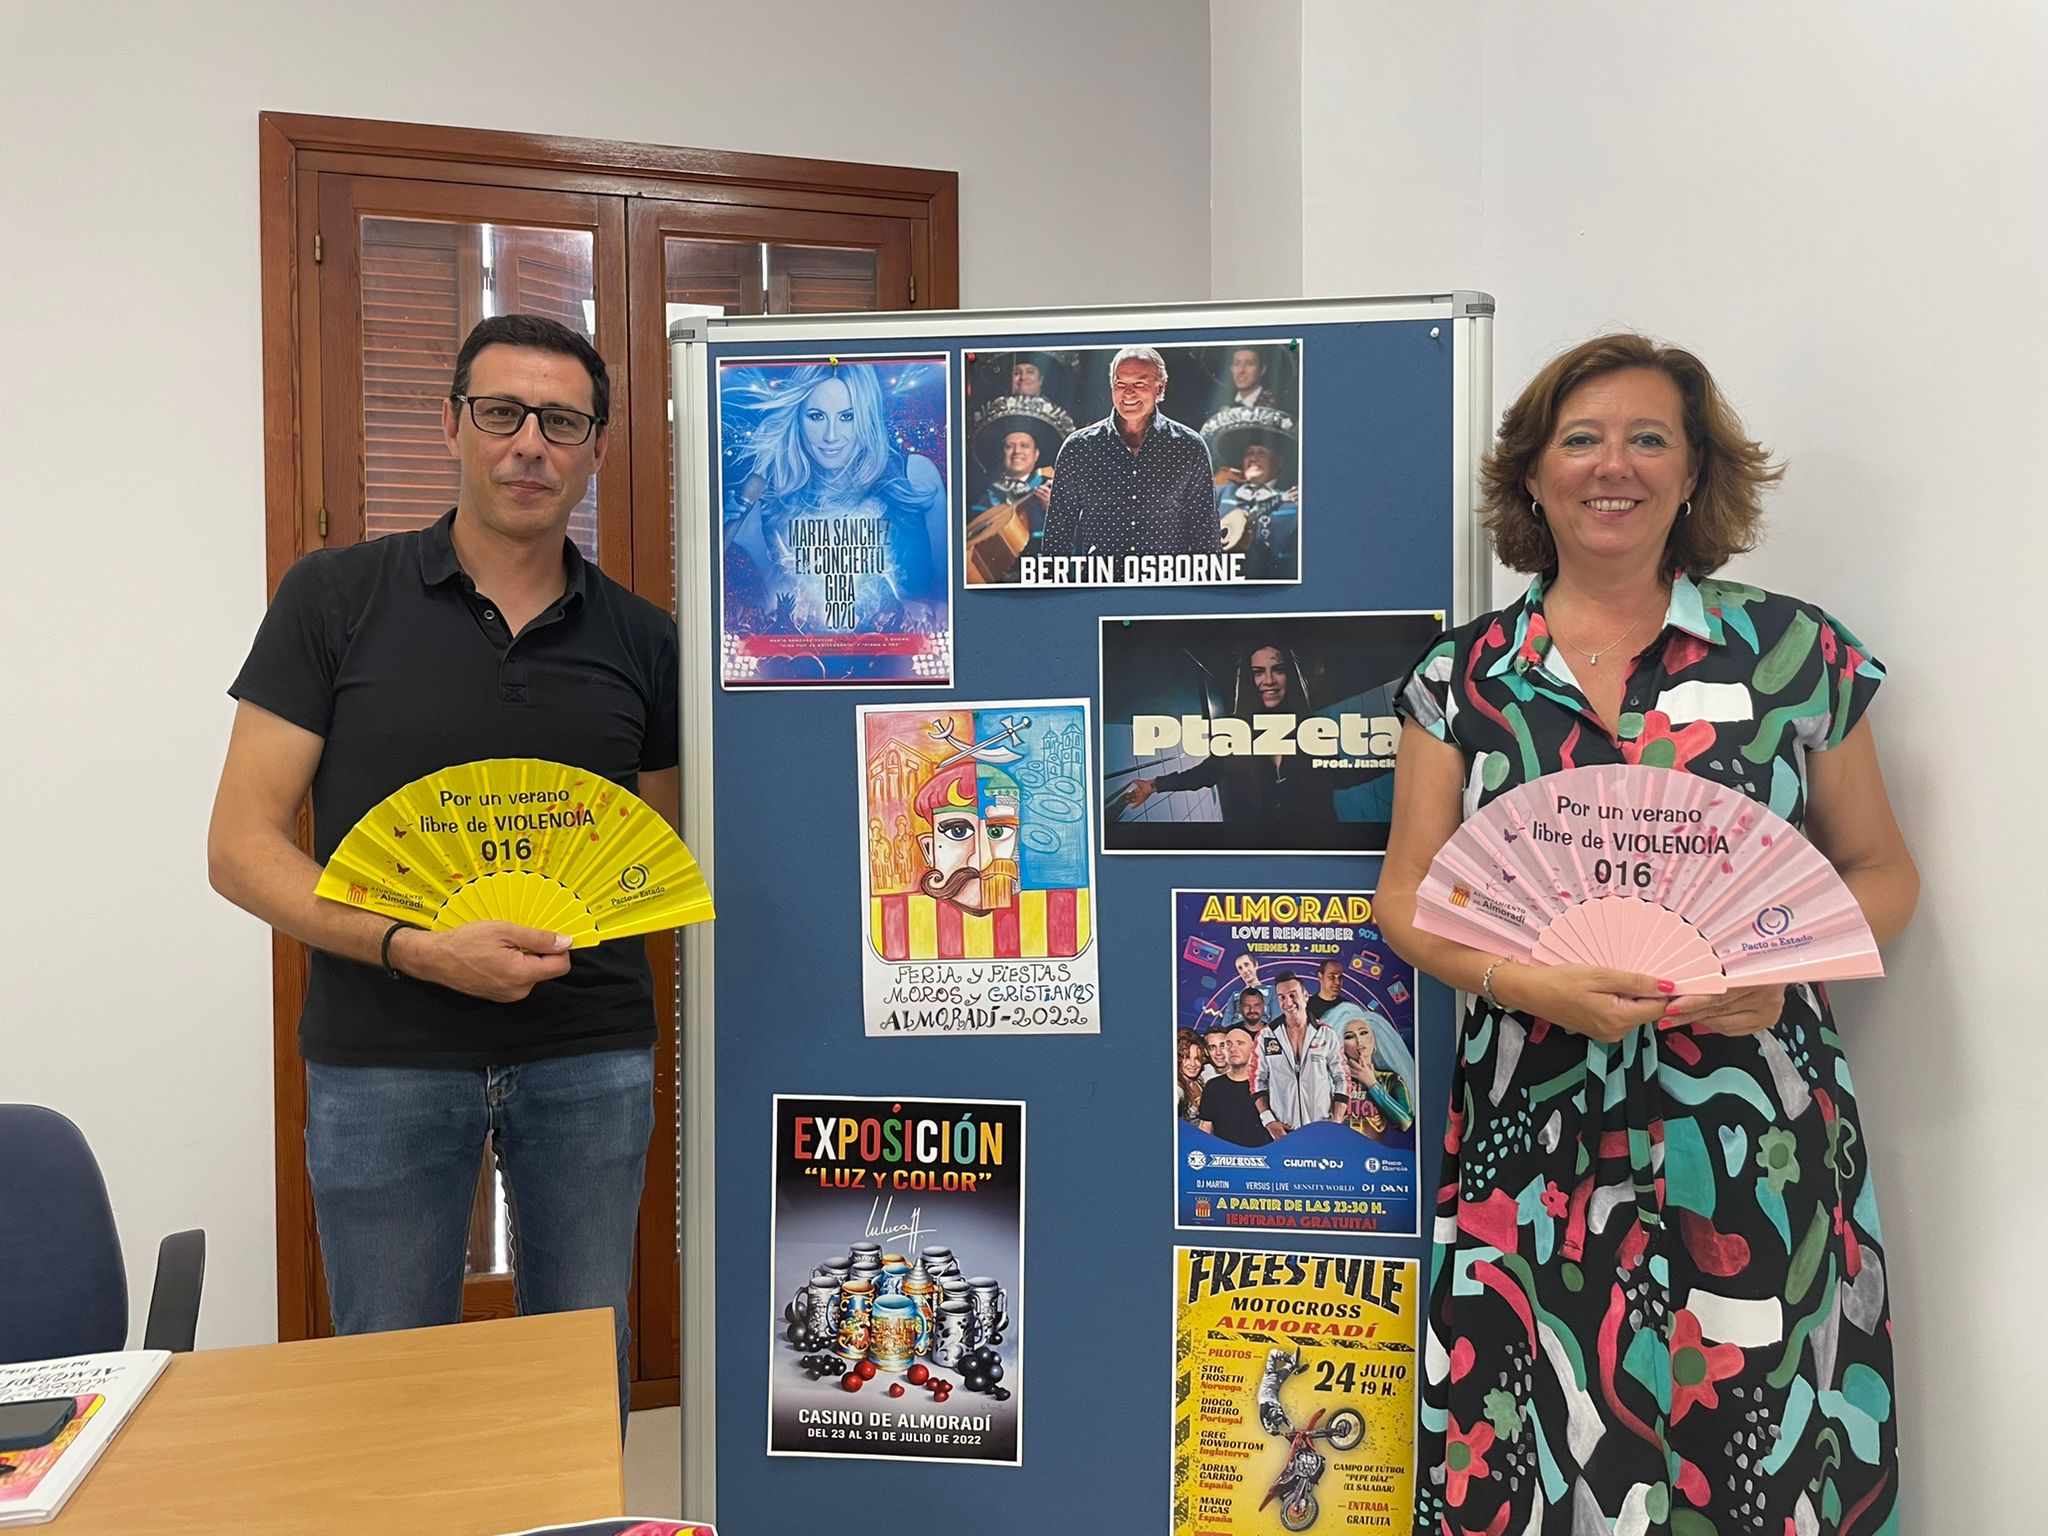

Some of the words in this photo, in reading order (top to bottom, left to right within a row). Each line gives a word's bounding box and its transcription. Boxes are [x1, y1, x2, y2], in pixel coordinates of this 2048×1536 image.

[788, 519, 830, 547] MARTA
[834, 514, 891, 546] SÁNCHEZ
[795, 547, 811, 575] EN
[814, 546, 884, 574] CONCIERTO
[1020, 545, 1114, 584] BERTÍN
[1123, 553, 1246, 583] OSBORNE
[825, 574, 856, 602] GIRA
[825, 601, 855, 630] 2020
[1132, 713, 1402, 757] PtaZeta
[1312, 758, 1353, 769] Prod.
[1354, 758, 1396, 769] Juack
[440, 790, 471, 807] Por
[479, 794, 502, 806] un
[509, 789, 570, 805] verano
[1556, 796, 1590, 817] Por
[1598, 806, 1624, 821] un
[1631, 808, 1702, 825] verano
[420, 816, 459, 834] libre
[466, 815, 488, 833] de
[494, 809, 596, 832] VIOLENCIA
[1532, 821, 1573, 847] libre
[1581, 828, 1604, 849] de
[1612, 833, 1730, 856] VIOLENCIA
[481, 838, 532, 862] 016
[1594, 859, 1652, 888] 016
[381, 893, 423, 909] Almoradí
[611, 896, 632, 905] Pacto
[640, 887, 665, 897] Estado
[1200, 894, 1377, 925] ALMORAD
[1482, 900, 1527, 924] Almoradí
[1231, 926, 1270, 939] LOVE
[1273, 927, 1354, 941] REMEMBER
[1247, 943, 1289, 953] VIERNES
[1290, 943, 1300, 953] 22
[1310, 944, 1340, 954] JULIO
[1741, 941, 1769, 951] Pacto
[1778, 935, 1813, 946] Estado
[883, 986, 963, 1005] MOROS
[794, 1112, 1003, 1166] EXPOSICIÓN
[1284, 1159, 1317, 1168] CHUMI
[1329, 1160, 1344, 1169] DJ
[872, 1172, 887, 1189] Y
[1196, 1180, 1204, 1189] DJ
[1205, 1180, 1229, 1189] MARTIN
[1246, 1181, 1270, 1191] VERSUS
[1276, 1182, 1289, 1191] LIVE
[1326, 1184, 1355, 1192] WORLD
[1362, 1183, 1375, 1195] DJ
[1381, 1184, 1408, 1192] DANI
[1216, 1197, 1228, 1210] A
[1230, 1198, 1281, 1211] PARTIR
[1284, 1199, 1302, 1211] DE
[1305, 1200, 1331, 1212] LAS
[1333, 1201, 1368, 1214] 23:30
[1371, 1201, 1387, 1215] H.
[1300, 1214, 1377, 1230] GRATUITA!
[1188, 1249, 1405, 1315] FREESTYLE
[1231, 1297, 1361, 1318] MOTOCROSS
[1216, 1315, 1380, 1338] ALMORADÍ
[1208, 1348, 1252, 1360] PILOTOS
[1201, 1364, 1224, 1374] STIG
[1314, 1360, 1355, 1393] 24
[1359, 1364, 1406, 1380] JULIO
[1200, 1373, 1244, 1384] FROSETH
[1200, 1382, 1242, 1393] Noruega
[1360, 1381, 1376, 1395] 19
[1381, 1382, 1397, 1396] H.
[1200, 1406, 1239, 1416] RIBEIRO
[799, 1408, 863, 1426] CASINO
[869, 1411, 892, 1428] DE
[898, 1413, 992, 1432] ALMORADÍ
[1200, 1414, 1243, 1425] Portugal
[807, 1428, 829, 1438] DEL
[831, 1429, 845, 1439] 23
[848, 1430, 863, 1440] AL
[865, 1431, 879, 1441] 31
[882, 1432, 897, 1441] DE
[900, 1432, 931, 1443] JULIO
[935, 1434, 950, 1444] DE
[952, 1434, 982, 1445] 2022
[1200, 1430, 1227, 1440] GREG
[1200, 1439, 1264, 1451] ROWBOTTOM
[1199, 1447, 1250, 1459] Inglaterra
[1200, 1463, 1236, 1473] ADRIAN
[1333, 1464, 1363, 1474] CAMPO
[1363, 1464, 1374, 1473] DE
[1199, 1472, 1243, 1482] GARRIDO
[1199, 1480, 1233, 1491] España
[1343, 1483, 1356, 1492] (EL
[1358, 1483, 1395, 1493] SALADAR)
[1200, 1497, 1233, 1507] MARIO
[1348, 1501, 1389, 1512] ENTRADA
[1199, 1505, 1230, 1515] LUCAS
[1198, 1513, 1233, 1524] España
[1346, 1515, 1391, 1527] GRATUITA
